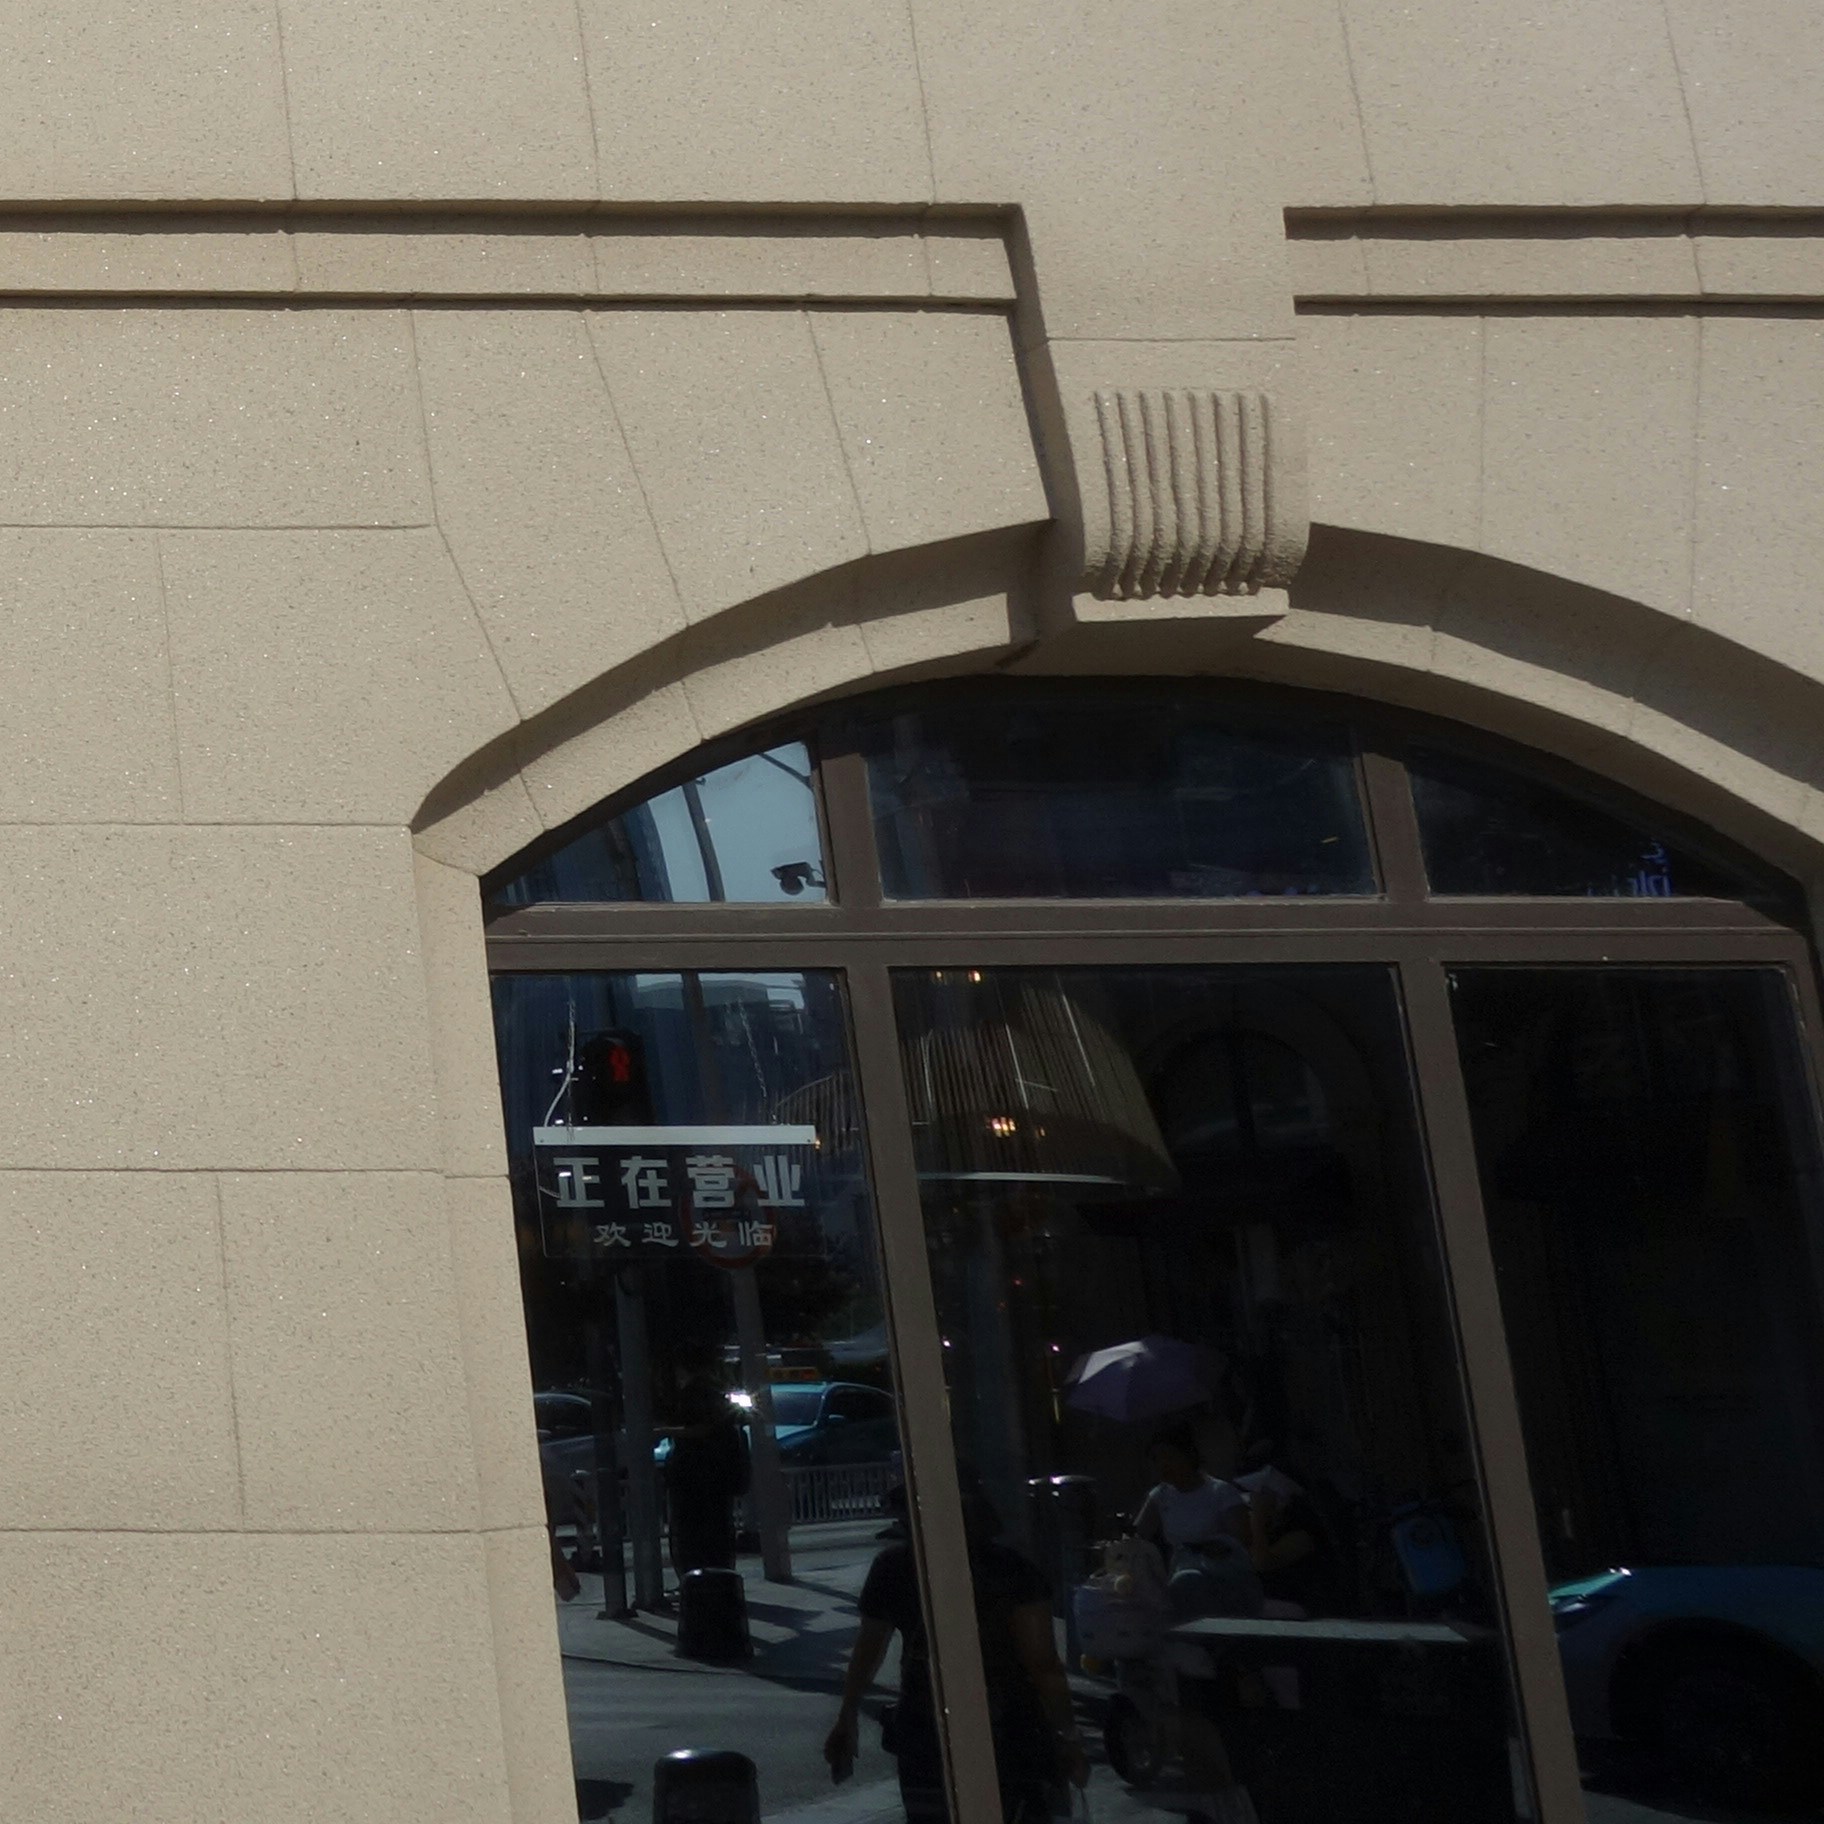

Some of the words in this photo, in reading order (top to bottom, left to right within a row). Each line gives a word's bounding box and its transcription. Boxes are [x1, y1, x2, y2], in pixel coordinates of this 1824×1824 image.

[553, 1154, 805, 1209] 正在营业
[592, 1222, 774, 1248] 欢迎光临
